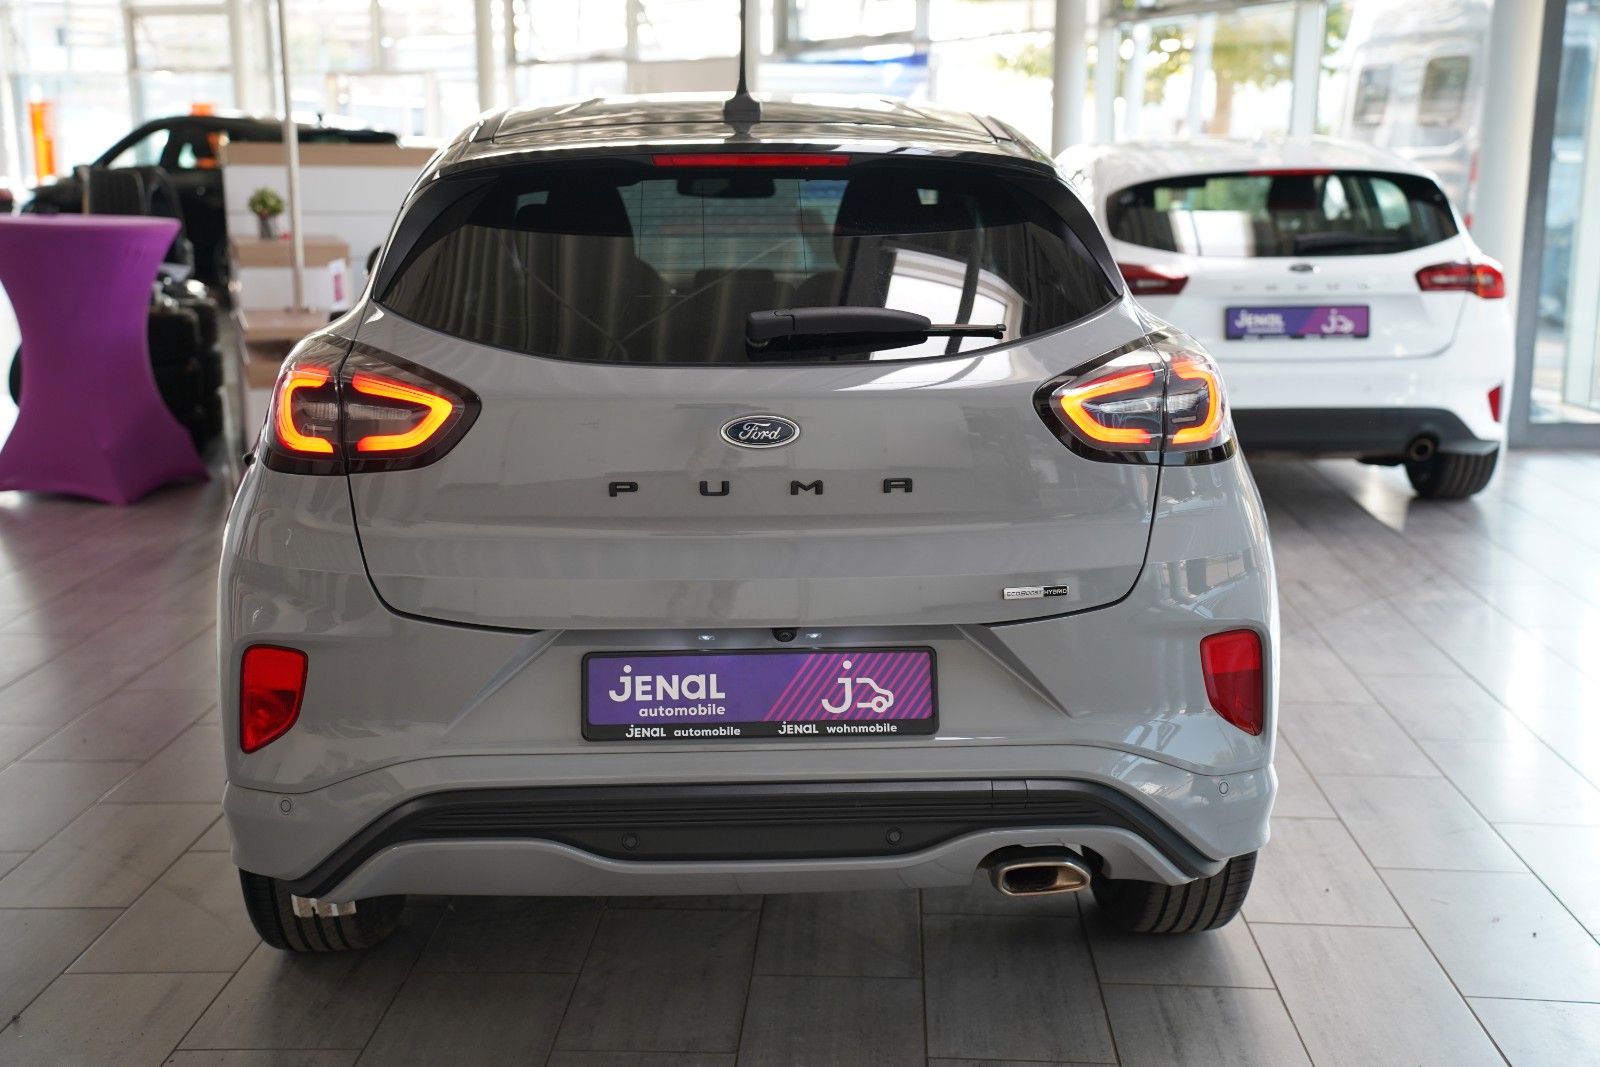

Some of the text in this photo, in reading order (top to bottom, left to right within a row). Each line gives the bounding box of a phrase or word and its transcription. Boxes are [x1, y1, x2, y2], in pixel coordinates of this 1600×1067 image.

[738, 422, 781, 440] Ford
[608, 477, 913, 498] PUMA
[638, 703, 726, 718] automobile
[673, 726, 741, 737] automobile
[826, 722, 898, 734] wohnmobile
